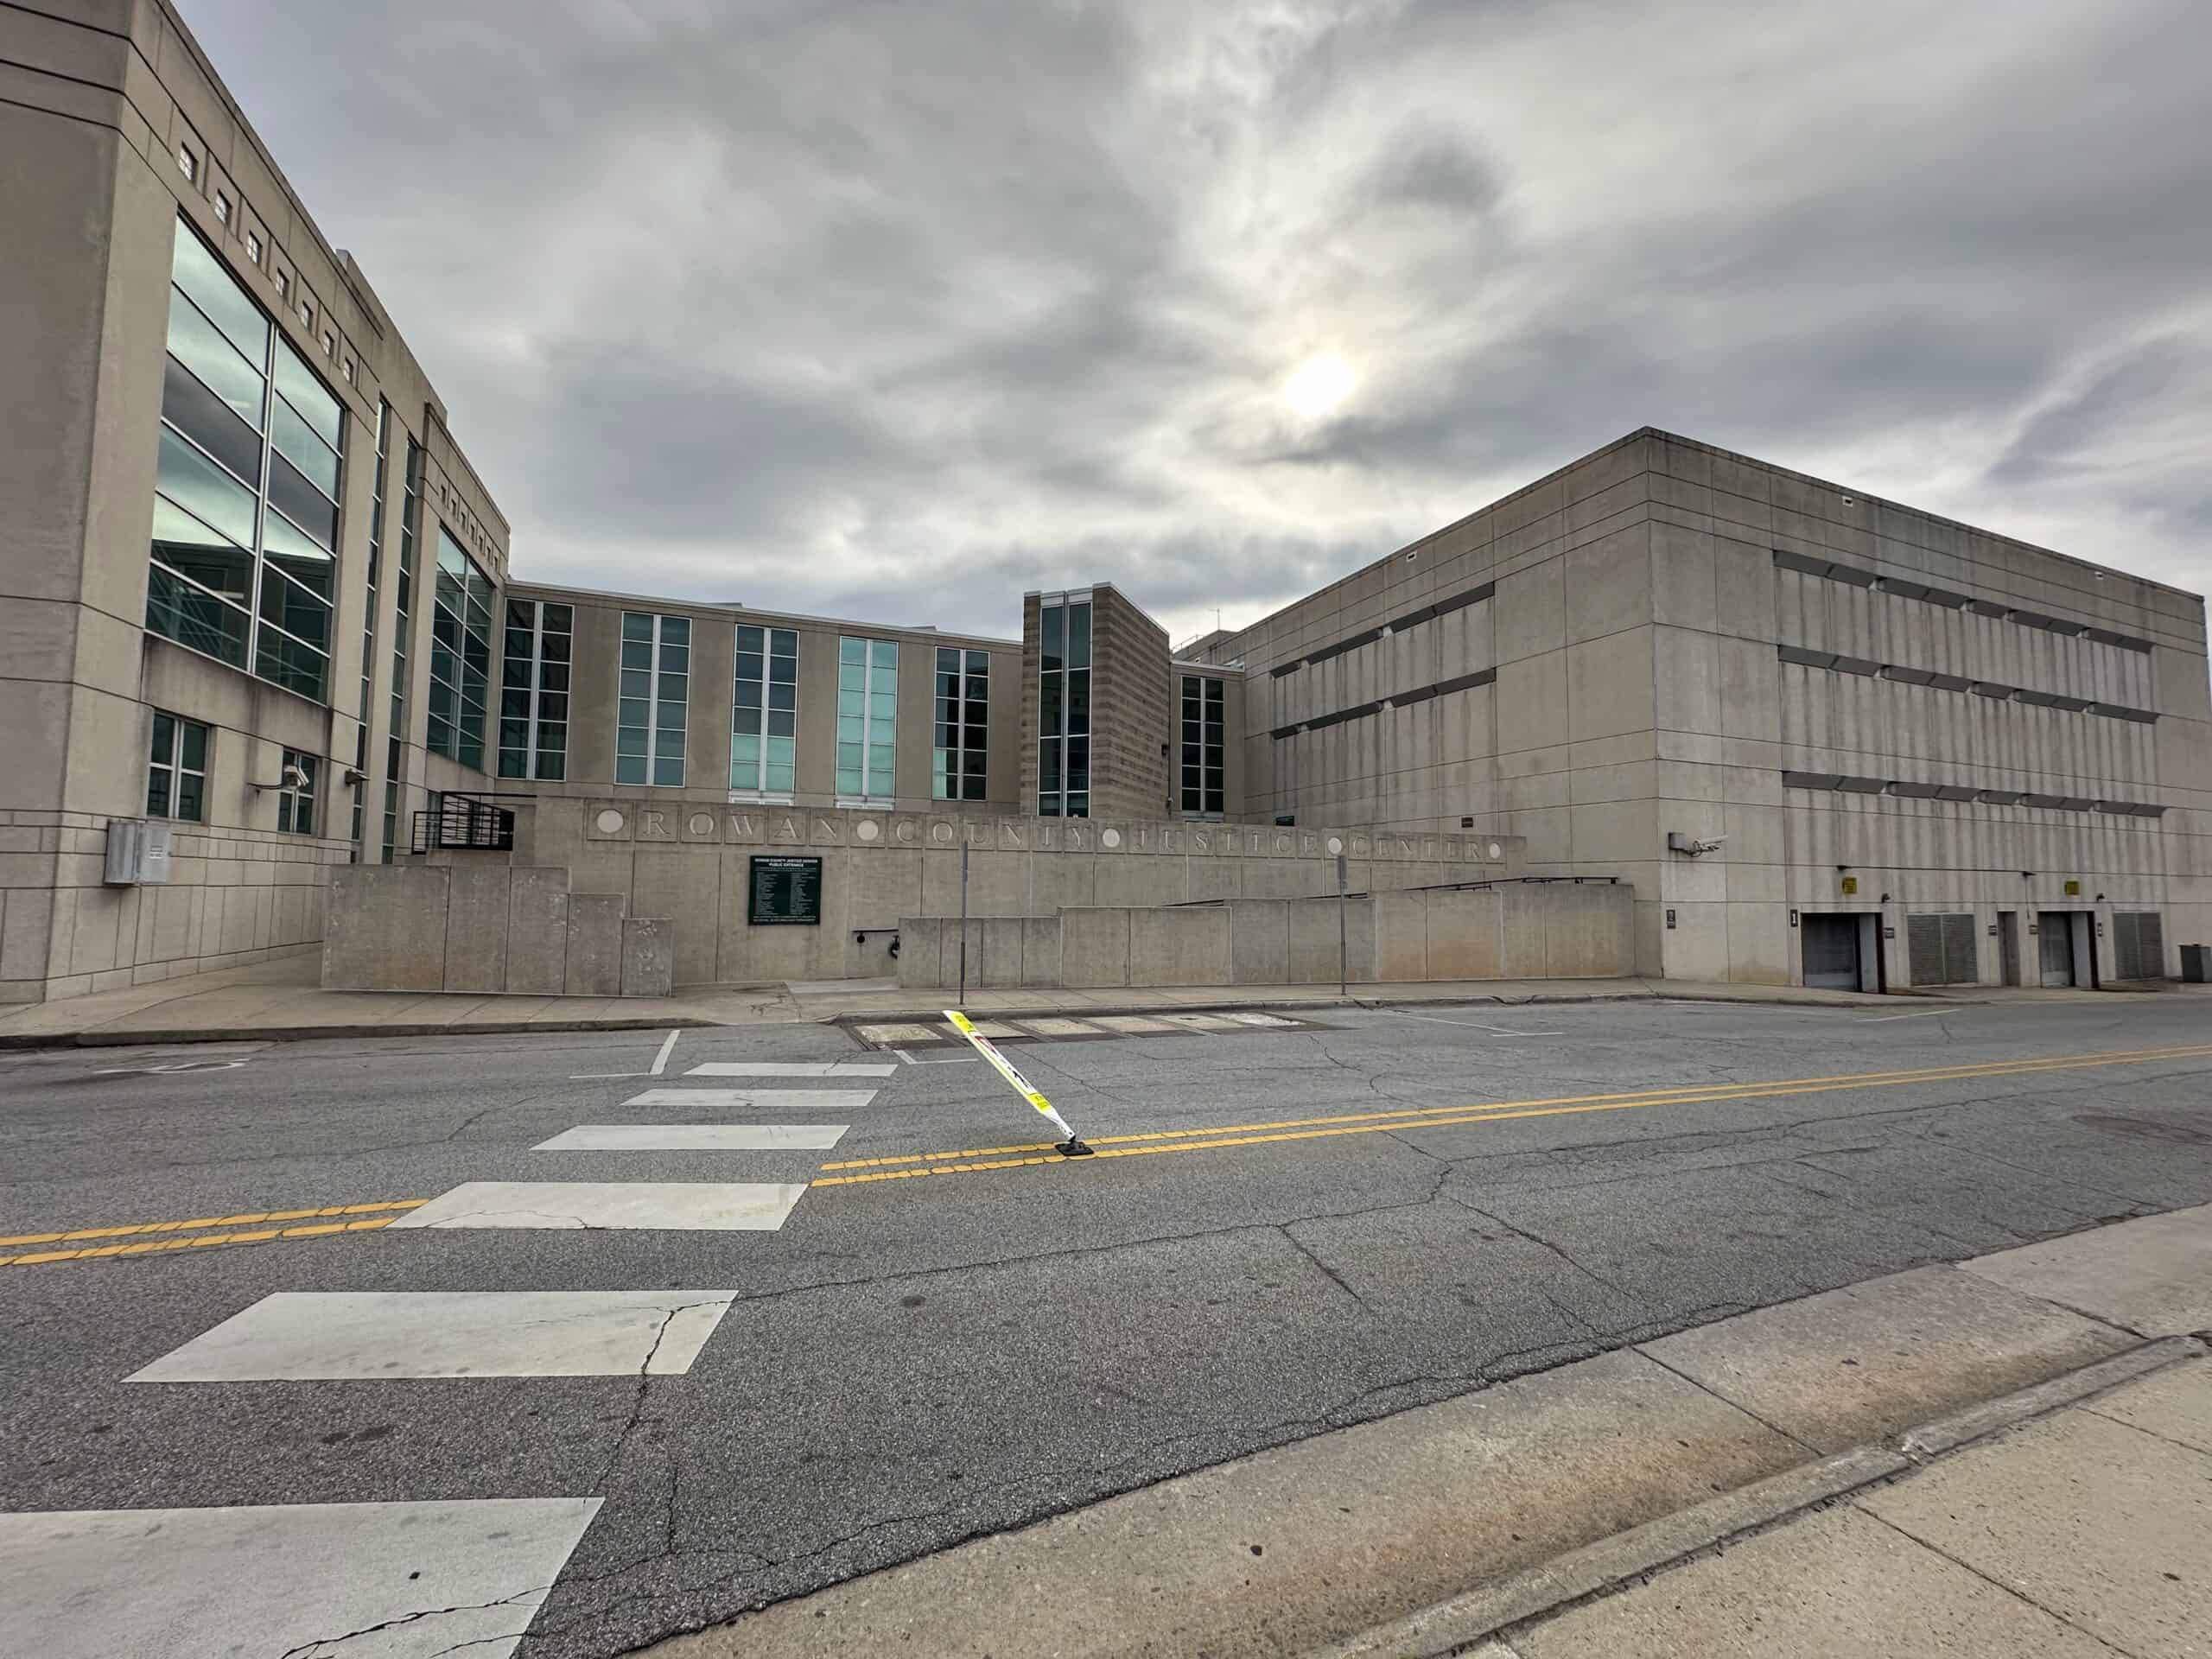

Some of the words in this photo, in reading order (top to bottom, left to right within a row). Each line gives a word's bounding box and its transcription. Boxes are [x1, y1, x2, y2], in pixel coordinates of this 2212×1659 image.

[642, 809, 842, 840] ROWAN
[897, 819, 1090, 847] COUNTY
[1136, 829, 1315, 853] JUSTICE
[1353, 836, 1481, 858] CENTER
